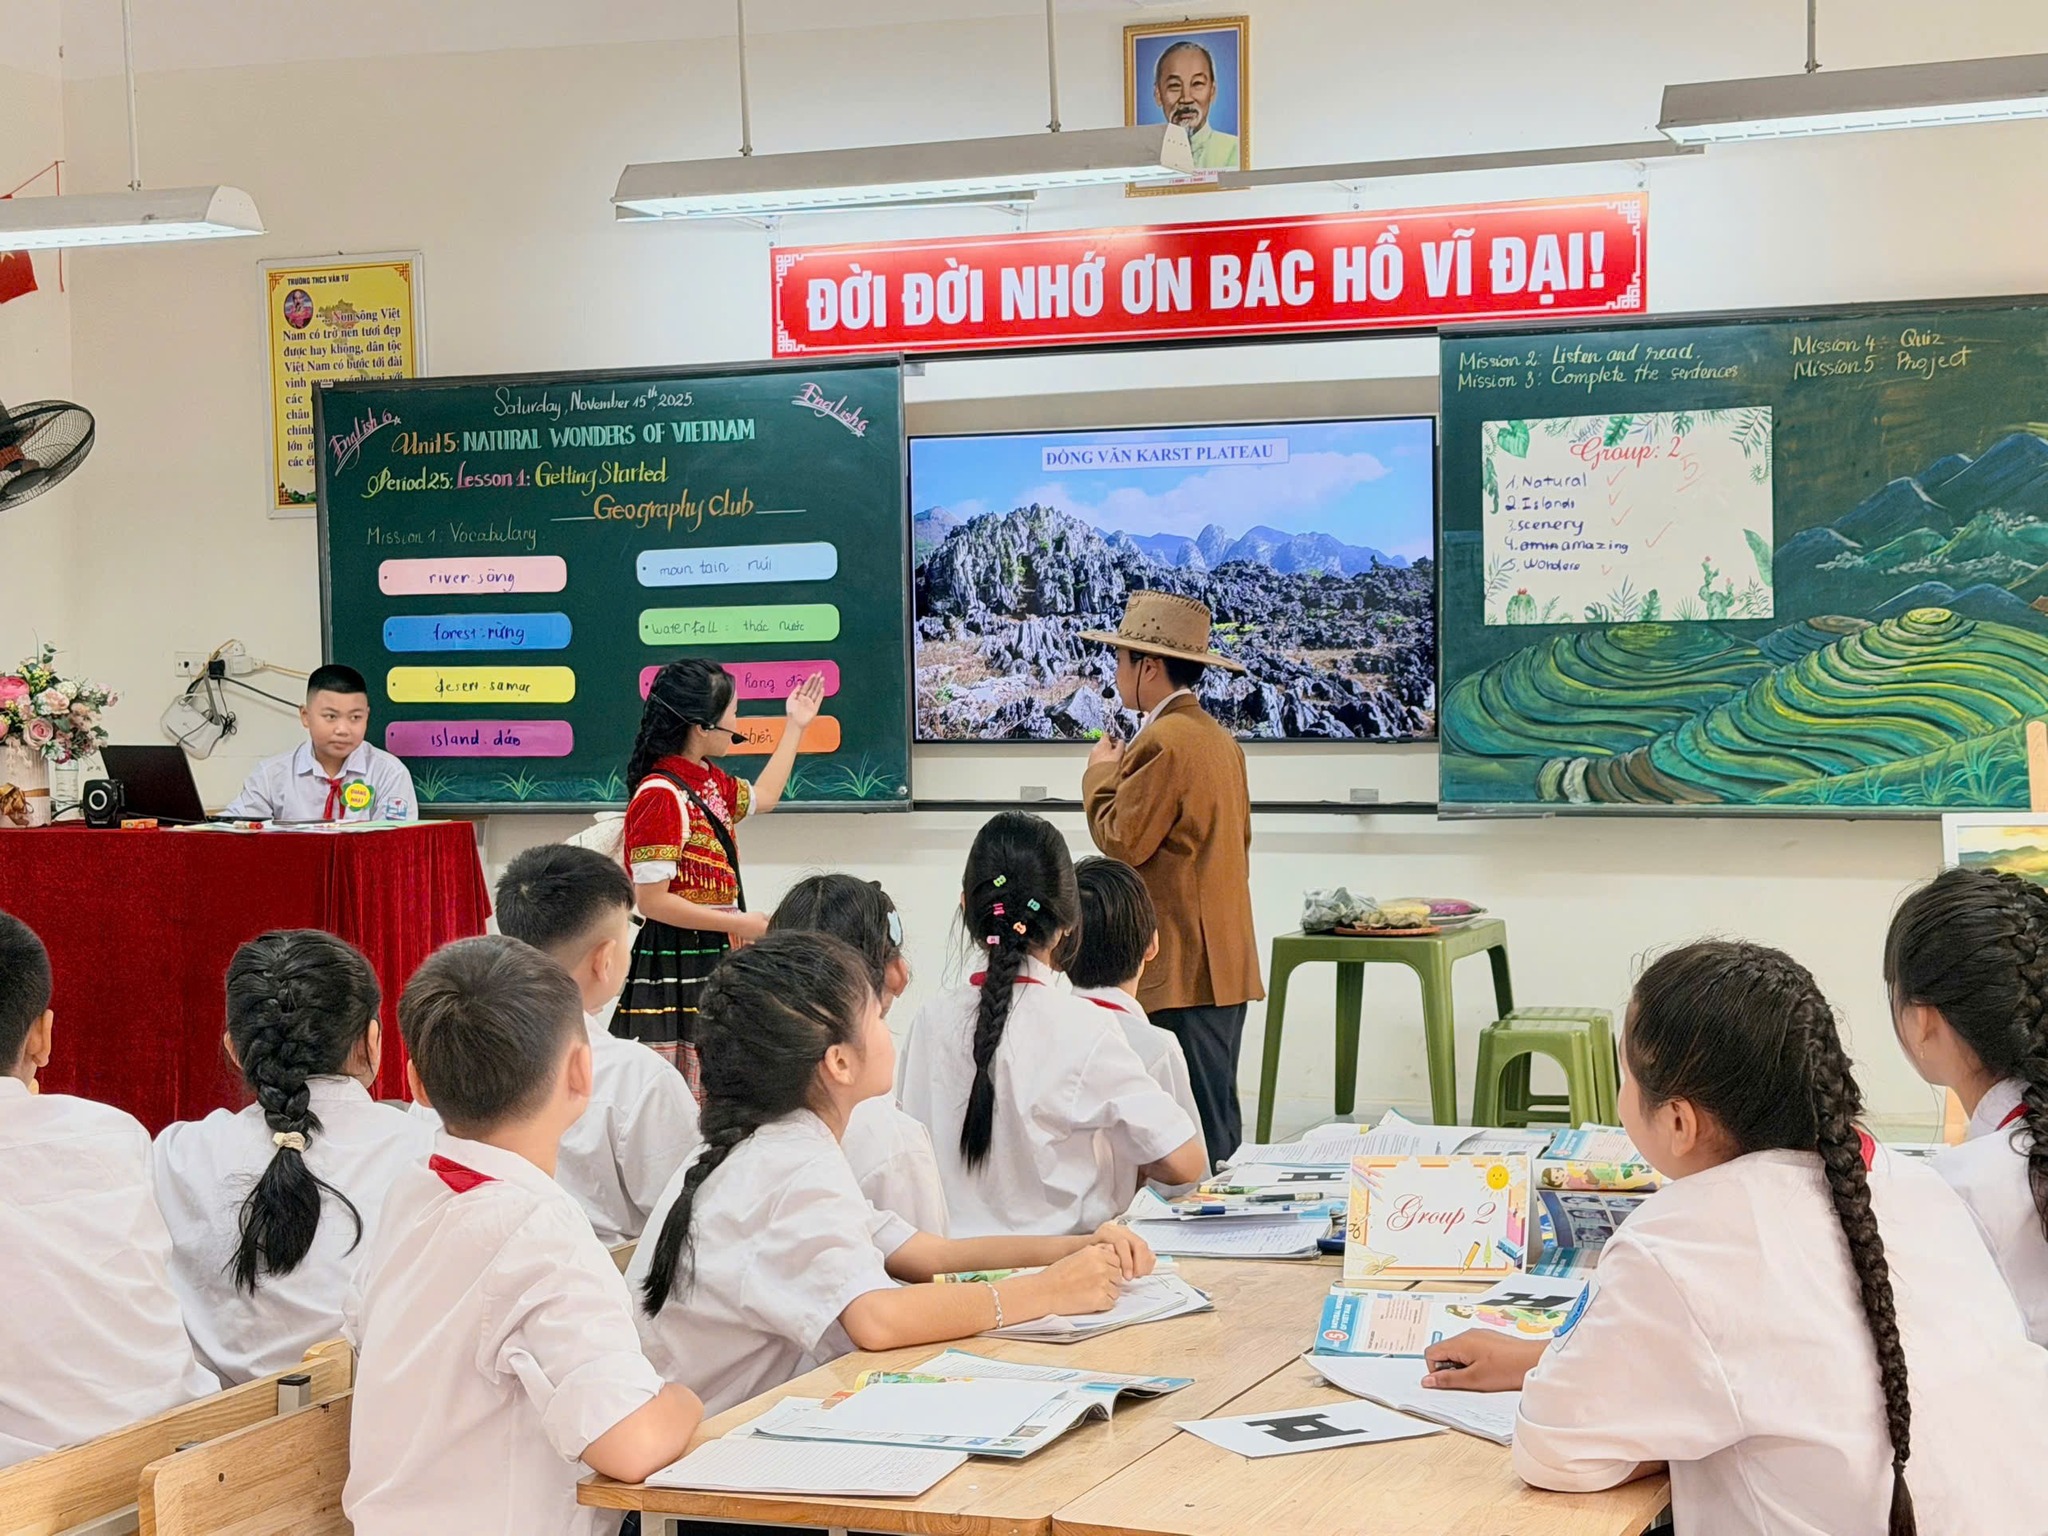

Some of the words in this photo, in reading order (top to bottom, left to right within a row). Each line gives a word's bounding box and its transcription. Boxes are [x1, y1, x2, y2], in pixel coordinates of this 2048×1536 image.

[806, 262, 887, 332] ĐỜI
[901, 256, 984, 327] ĐỜI
[1000, 250, 1106, 322] NHỚ
[1121, 252, 1192, 315] ƠN
[1209, 239, 1315, 310] BÁC
[1332, 224, 1404, 304] HỒ
[1420, 226, 1476, 299] VĨ
[1488, 230, 1606, 306] ĐẠI!
[381, 308, 401, 323] Việt
[282, 330, 306, 342] Nam
[309, 327, 320, 340] có
[383, 324, 402, 338] đẹp
[1792, 334, 1861, 356] Mission
[1900, 328, 1945, 348] Quiz
[283, 345, 307, 359] được
[310, 344, 327, 358] hay
[366, 341, 385, 353] dân
[387, 339, 402, 353] tộc
[1458, 351, 1522, 371] Mission
[1552, 344, 1602, 365] Listen
[1606, 342, 1637, 363] and
[284, 361, 305, 376] Việt
[307, 360, 331, 372] Nam
[333, 358, 344, 370] có
[1793, 358, 1861, 380] Mission
[1897, 345, 1972, 380] Project
[285, 376, 307, 389] vinh
[1458, 371, 1518, 392] Mission
[1551, 365, 1628, 394] Complete
[1634, 362, 1659, 383] the
[285, 393, 303, 404] các
[571, 389, 630, 412] November
[286, 408, 310, 420] châu
[287, 440, 303, 452] lớn
[328, 407, 377, 470] English
[463, 427, 541, 452] NATURAL
[549, 422, 636, 449] WONDERS
[643, 421, 665, 444] OF
[671, 418, 756, 443] VIETNAM
[288, 456, 304, 468] các
[1098, 446, 1132, 464] VĂN
[1137, 446, 1193, 463] KARST
[1196, 443, 1274, 460] PLATEAU
[1570, 436, 1660, 470] Group:
[1667, 436, 1684, 459] 2
[361, 466, 427, 498] Period
[455, 460, 514, 490] Lesson
[535, 460, 598, 496] Getting
[599, 456, 670, 485] Started
[1522, 472, 1587, 489] Natural
[593, 488, 706, 533] Geography
[708, 487, 754, 516] Club
[366, 525, 424, 546] Mission
[450, 518, 537, 551] Vocabulary
[1561, 540, 1629, 555] amazing
[742, 619, 770, 633] thác
[744, 671, 776, 694] hang
[1386, 1193, 1466, 1235] Group
[1471, 1201, 1497, 1225] 2
